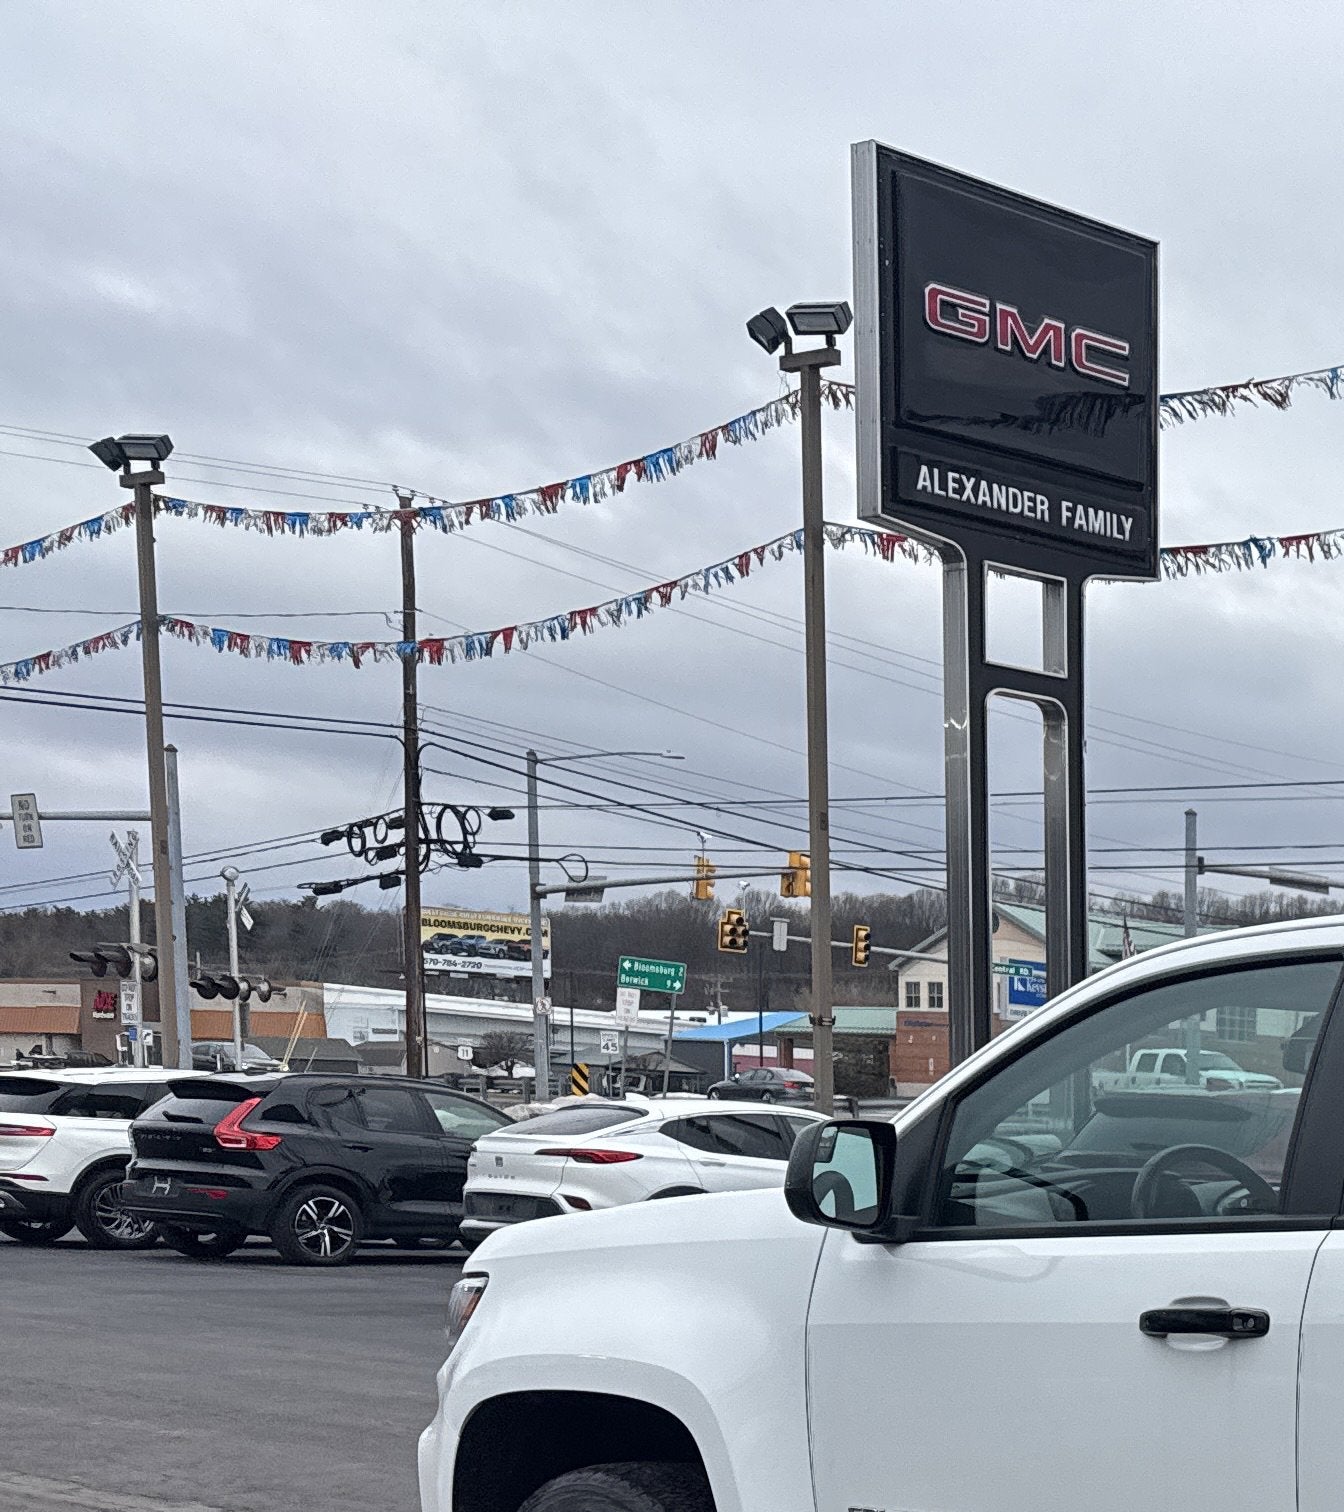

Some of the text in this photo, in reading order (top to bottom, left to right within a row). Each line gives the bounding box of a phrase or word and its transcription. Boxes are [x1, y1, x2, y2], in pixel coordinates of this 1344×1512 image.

[924, 281, 1130, 388] GMC
[916, 464, 1133, 542] ALEXANDER FAMILY
[421, 917, 548, 938] BLOOMSBURGCHEVY.CM
[633, 961, 675, 977] Bloomsburg
[620, 973, 649, 986] Berwick
[602, 1042, 618, 1052] 45
